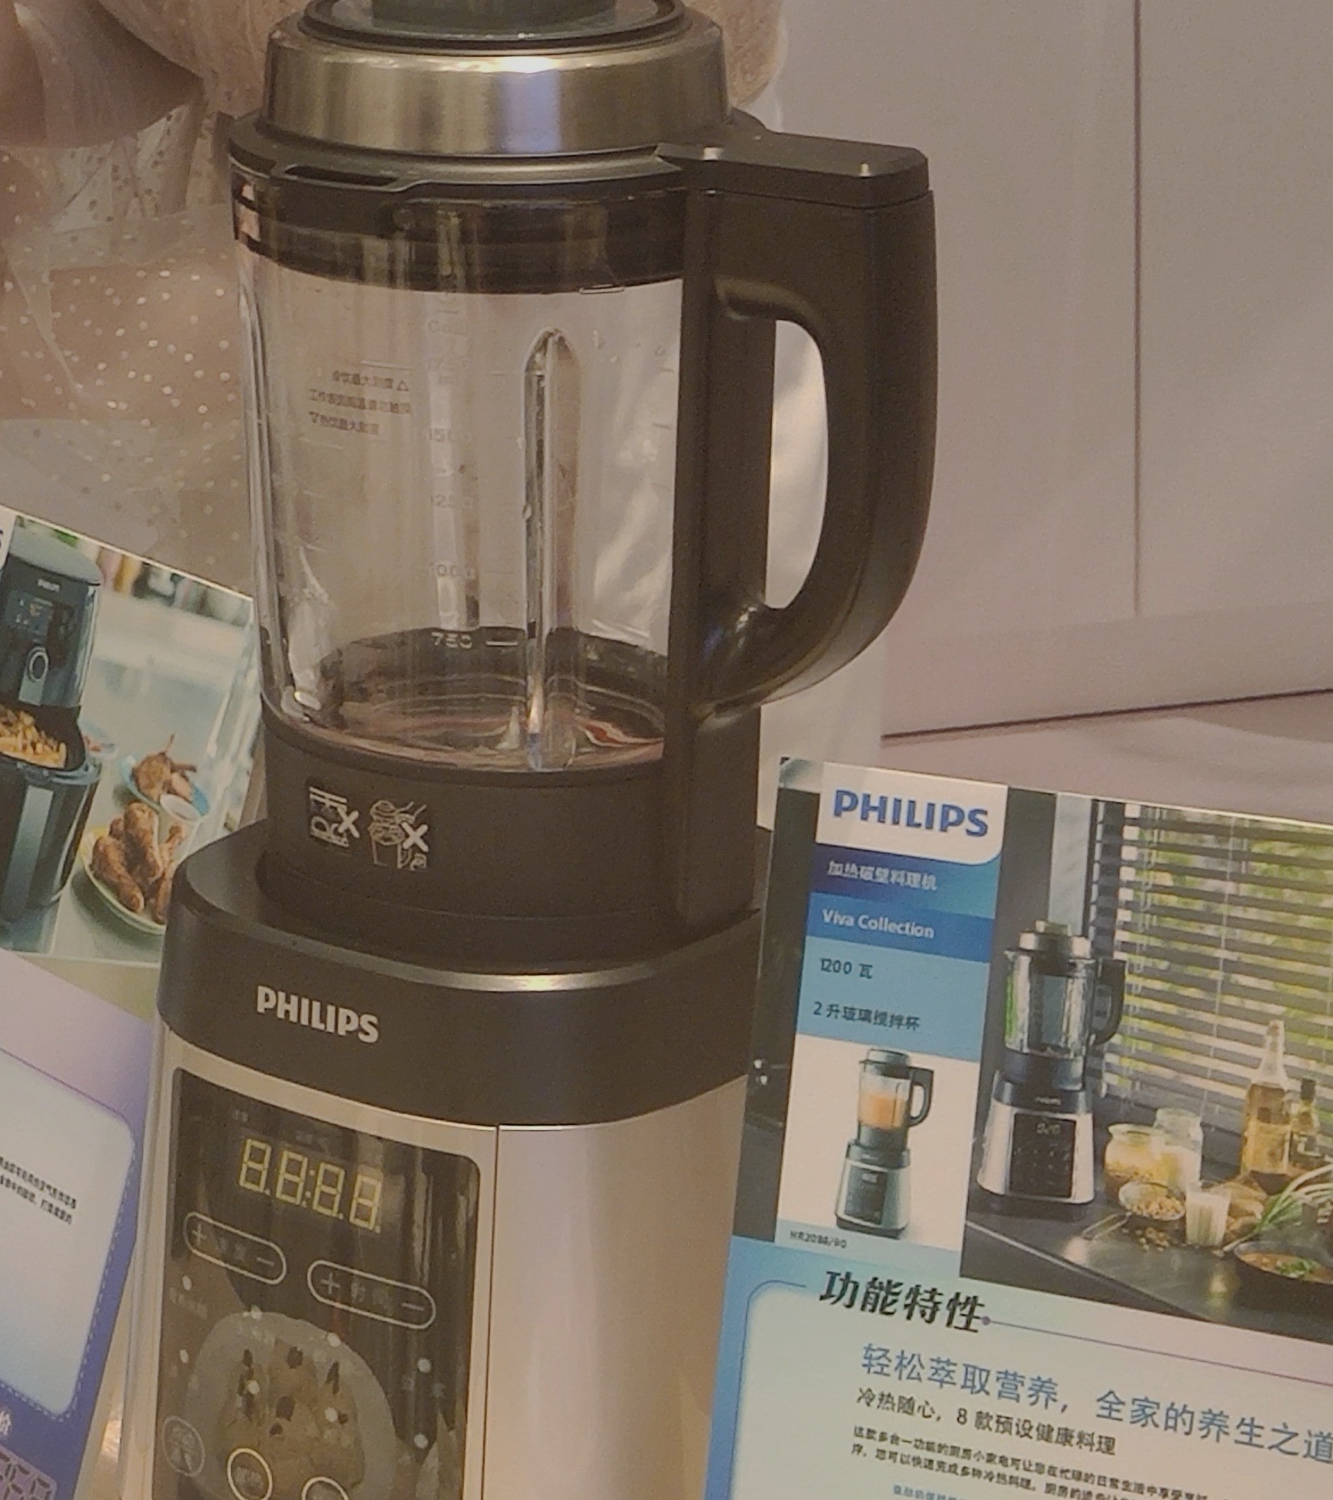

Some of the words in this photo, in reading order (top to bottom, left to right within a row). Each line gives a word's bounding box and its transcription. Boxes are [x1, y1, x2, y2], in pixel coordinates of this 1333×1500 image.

[834, 789, 989, 838] PHILIPS
[822, 908, 855, 928] Viva
[858, 914, 934, 939] Collection
[820, 957, 853, 975] 1200
[256, 985, 379, 1044] PHILIPS
[820, 1269, 985, 1333] 功能特性
